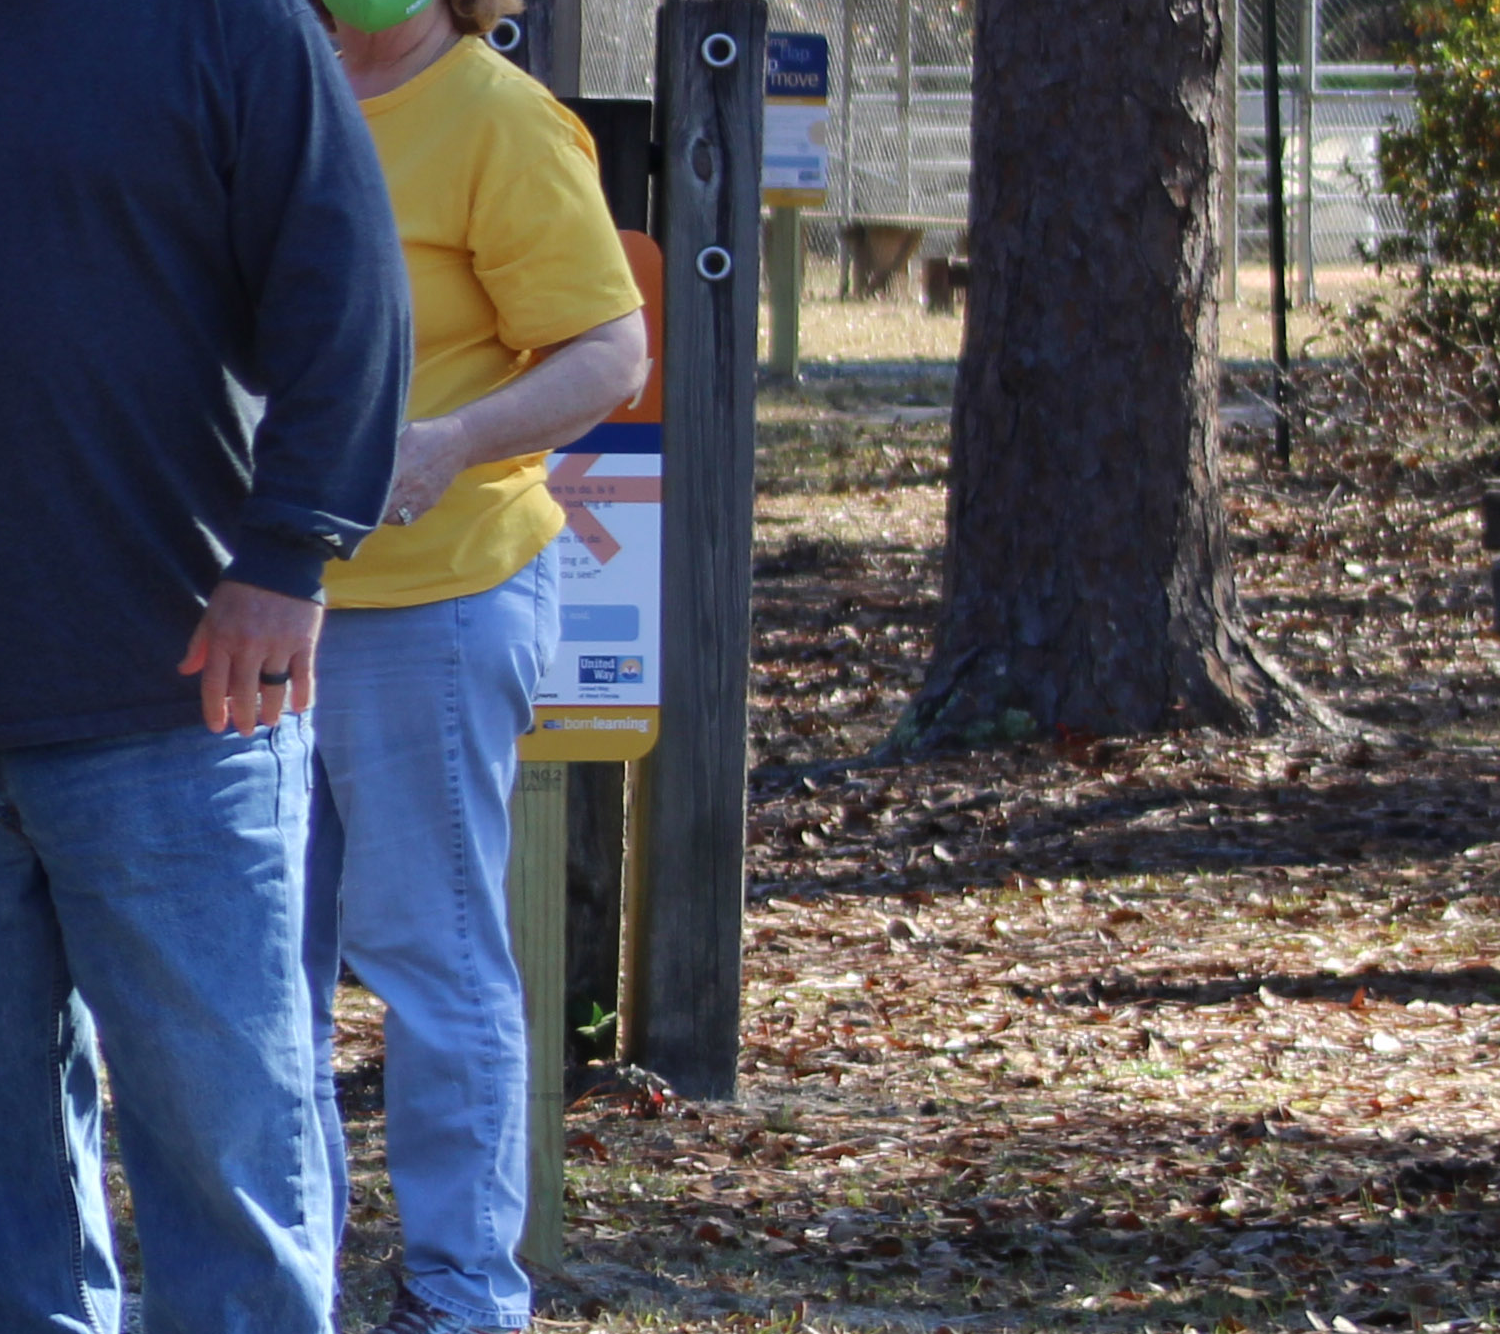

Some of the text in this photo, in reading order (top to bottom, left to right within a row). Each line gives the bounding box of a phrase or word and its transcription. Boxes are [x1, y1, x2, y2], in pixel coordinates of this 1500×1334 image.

[771, 72, 819, 87] move
[580, 659, 615, 669] United
[593, 670, 614, 681] Way
[564, 716, 648, 733] bornlearning
